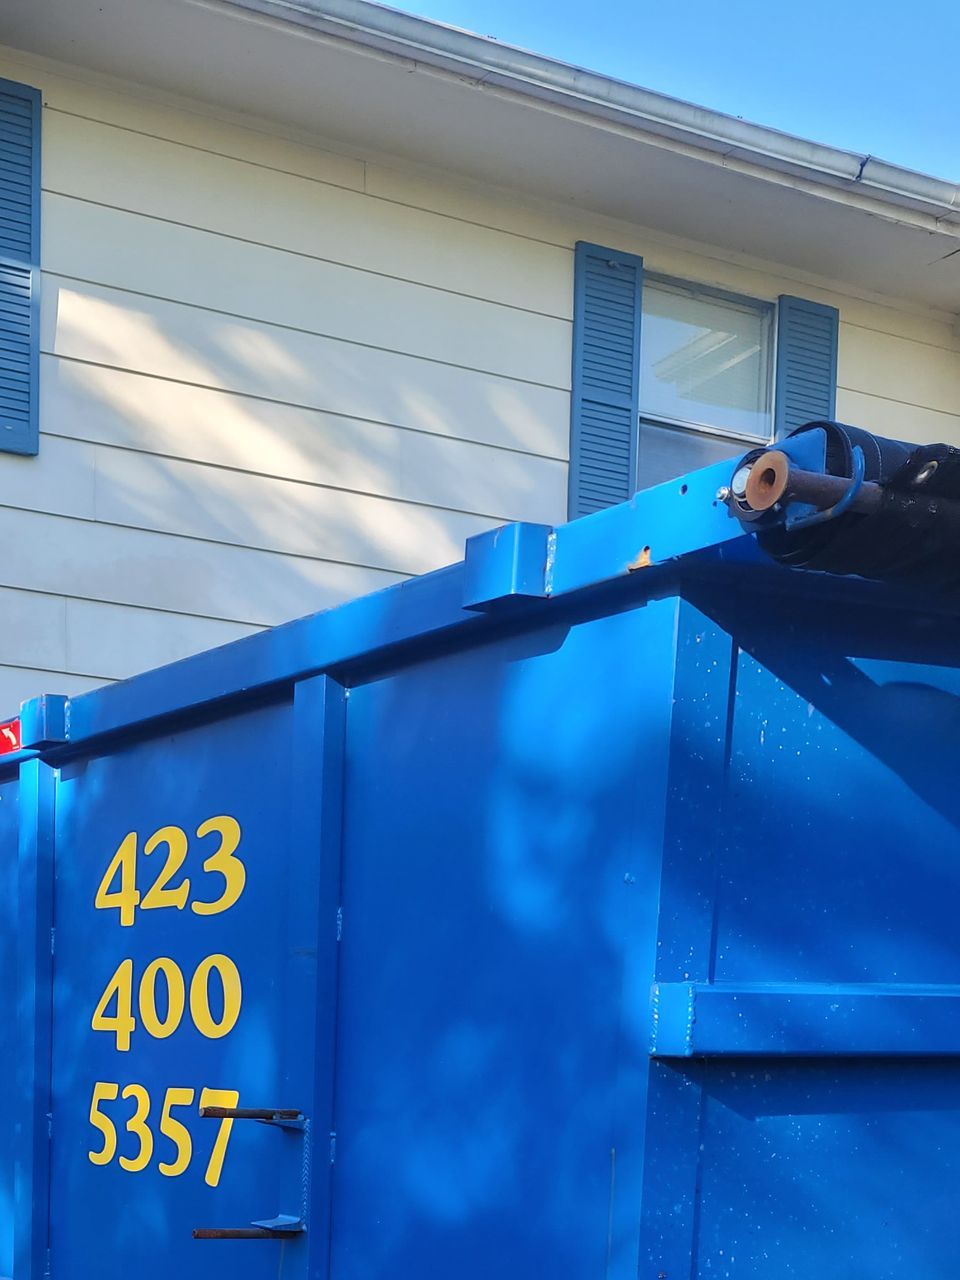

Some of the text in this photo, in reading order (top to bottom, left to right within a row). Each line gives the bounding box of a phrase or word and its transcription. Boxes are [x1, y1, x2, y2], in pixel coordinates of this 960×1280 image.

[95, 815, 246, 927] 423
[91, 953, 242, 1051] 400
[88, 1082, 240, 1187] 5357
